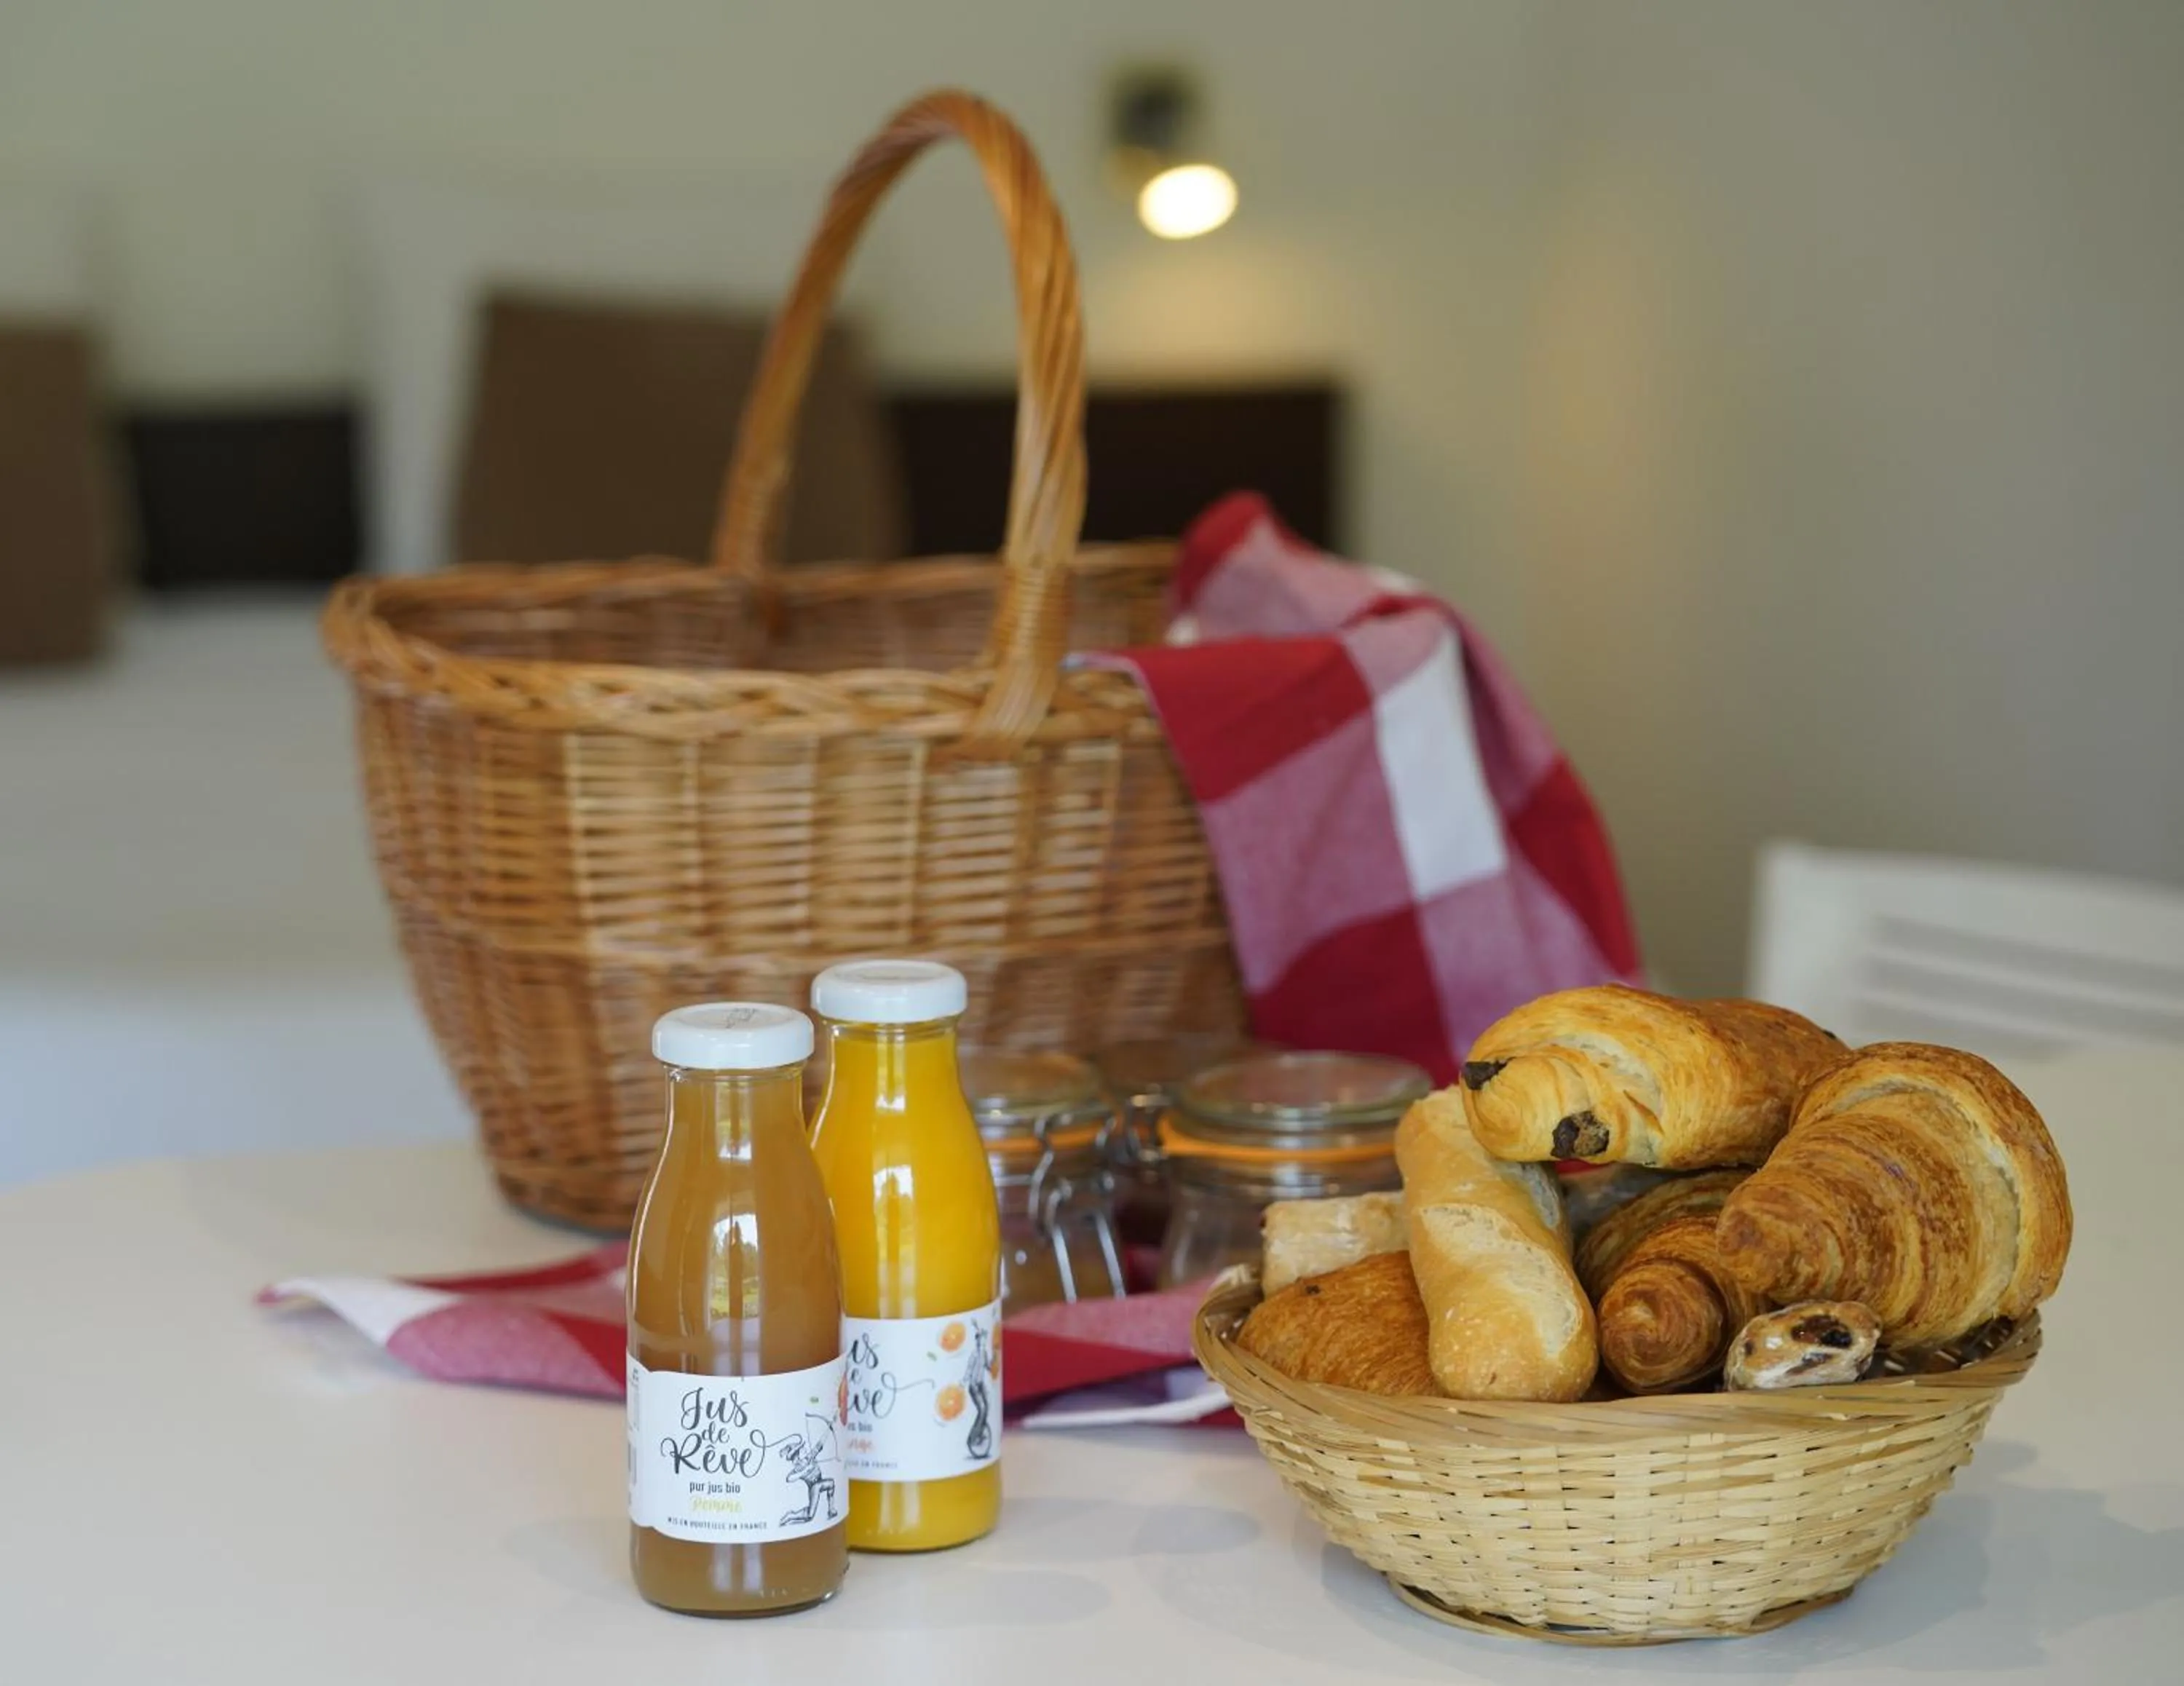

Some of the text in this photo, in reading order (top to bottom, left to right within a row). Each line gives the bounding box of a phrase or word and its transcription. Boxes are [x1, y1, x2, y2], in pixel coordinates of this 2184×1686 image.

[681, 1387, 750, 1430] Jus
[701, 1421, 730, 1444] de
[660, 1429, 766, 1478] Rêve
[689, 1481, 741, 1495] pur jus bio
[740, 1521, 767, 1530] FRANCE
